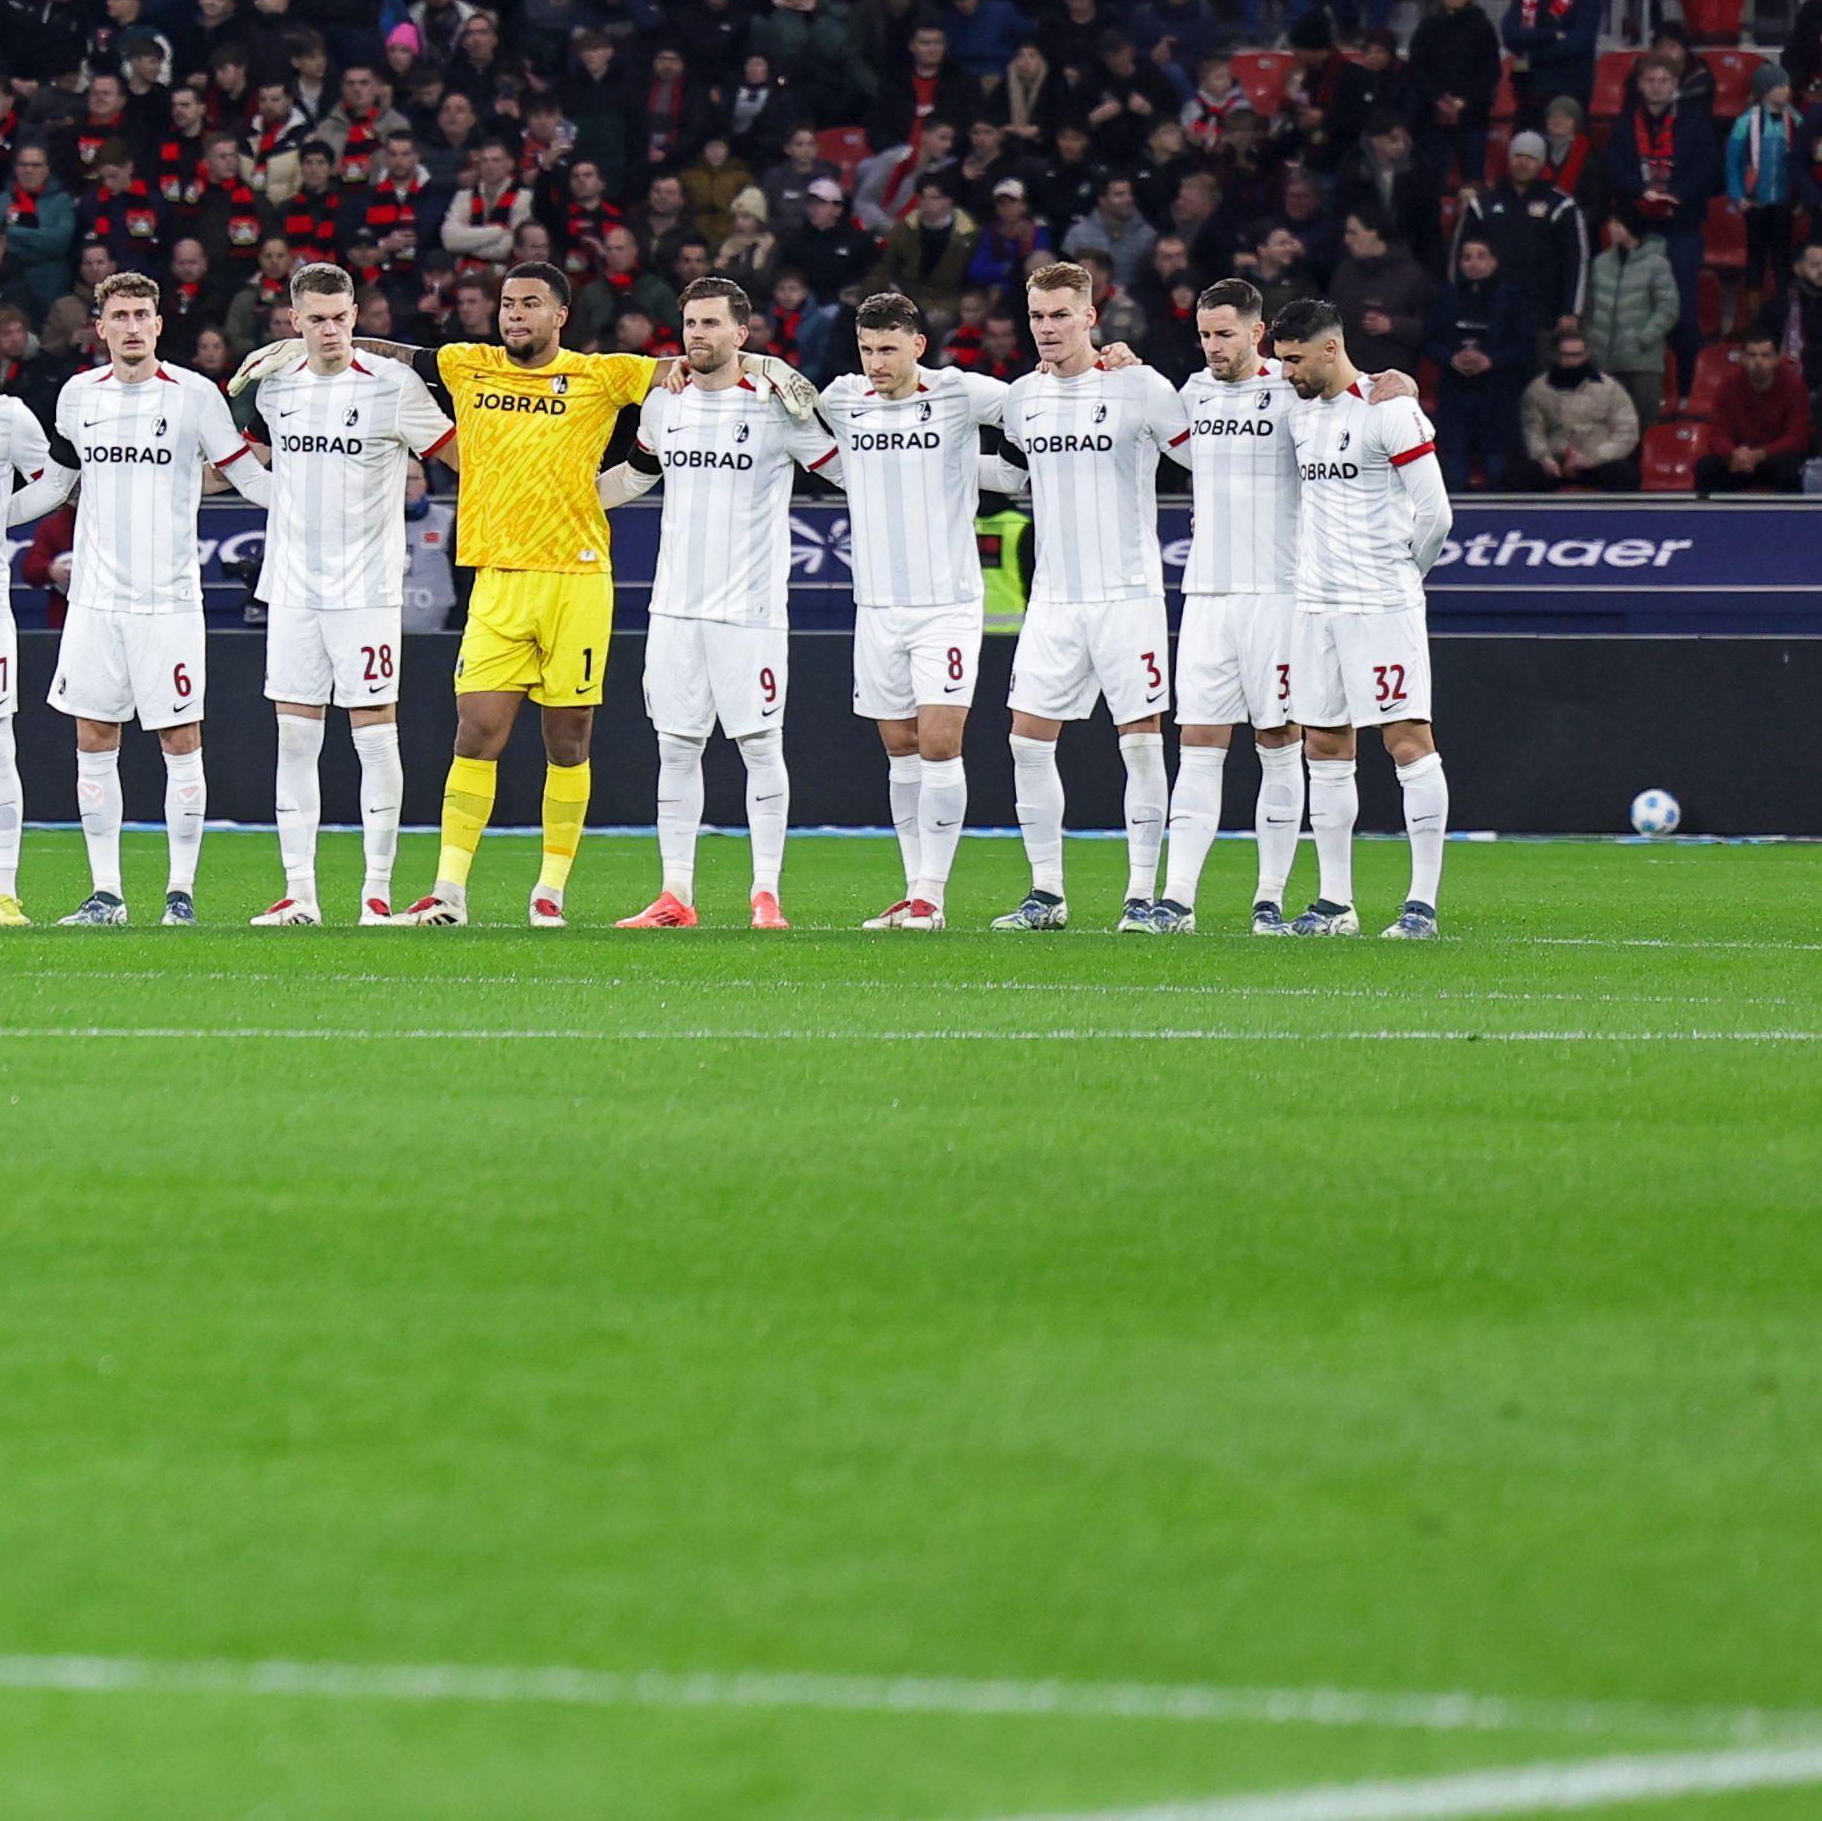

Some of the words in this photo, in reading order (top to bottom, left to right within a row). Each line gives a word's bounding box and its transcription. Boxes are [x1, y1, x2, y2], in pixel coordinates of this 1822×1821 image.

[472, 392, 566, 417] JOBRAD
[851, 431, 941, 452] JOBRAD
[1190, 419, 1274, 438] JOBRAD
[83, 445, 172, 466] JOBRAD
[280, 434, 363, 455] JOBRAD
[1025, 434, 1113, 455] JOBRAD
[663, 450, 753, 471] JOBRAD
[1298, 462, 1358, 480] OBRAD
[360, 643, 394, 681] 28
[581, 647, 592, 682] 1
[946, 646, 964, 681] 8
[1140, 650, 1162, 689] 3
[172, 662, 193, 698] 6
[759, 666, 777, 703] 9
[1276, 663, 1290, 701] 3
[1373, 663, 1407, 702] 32
